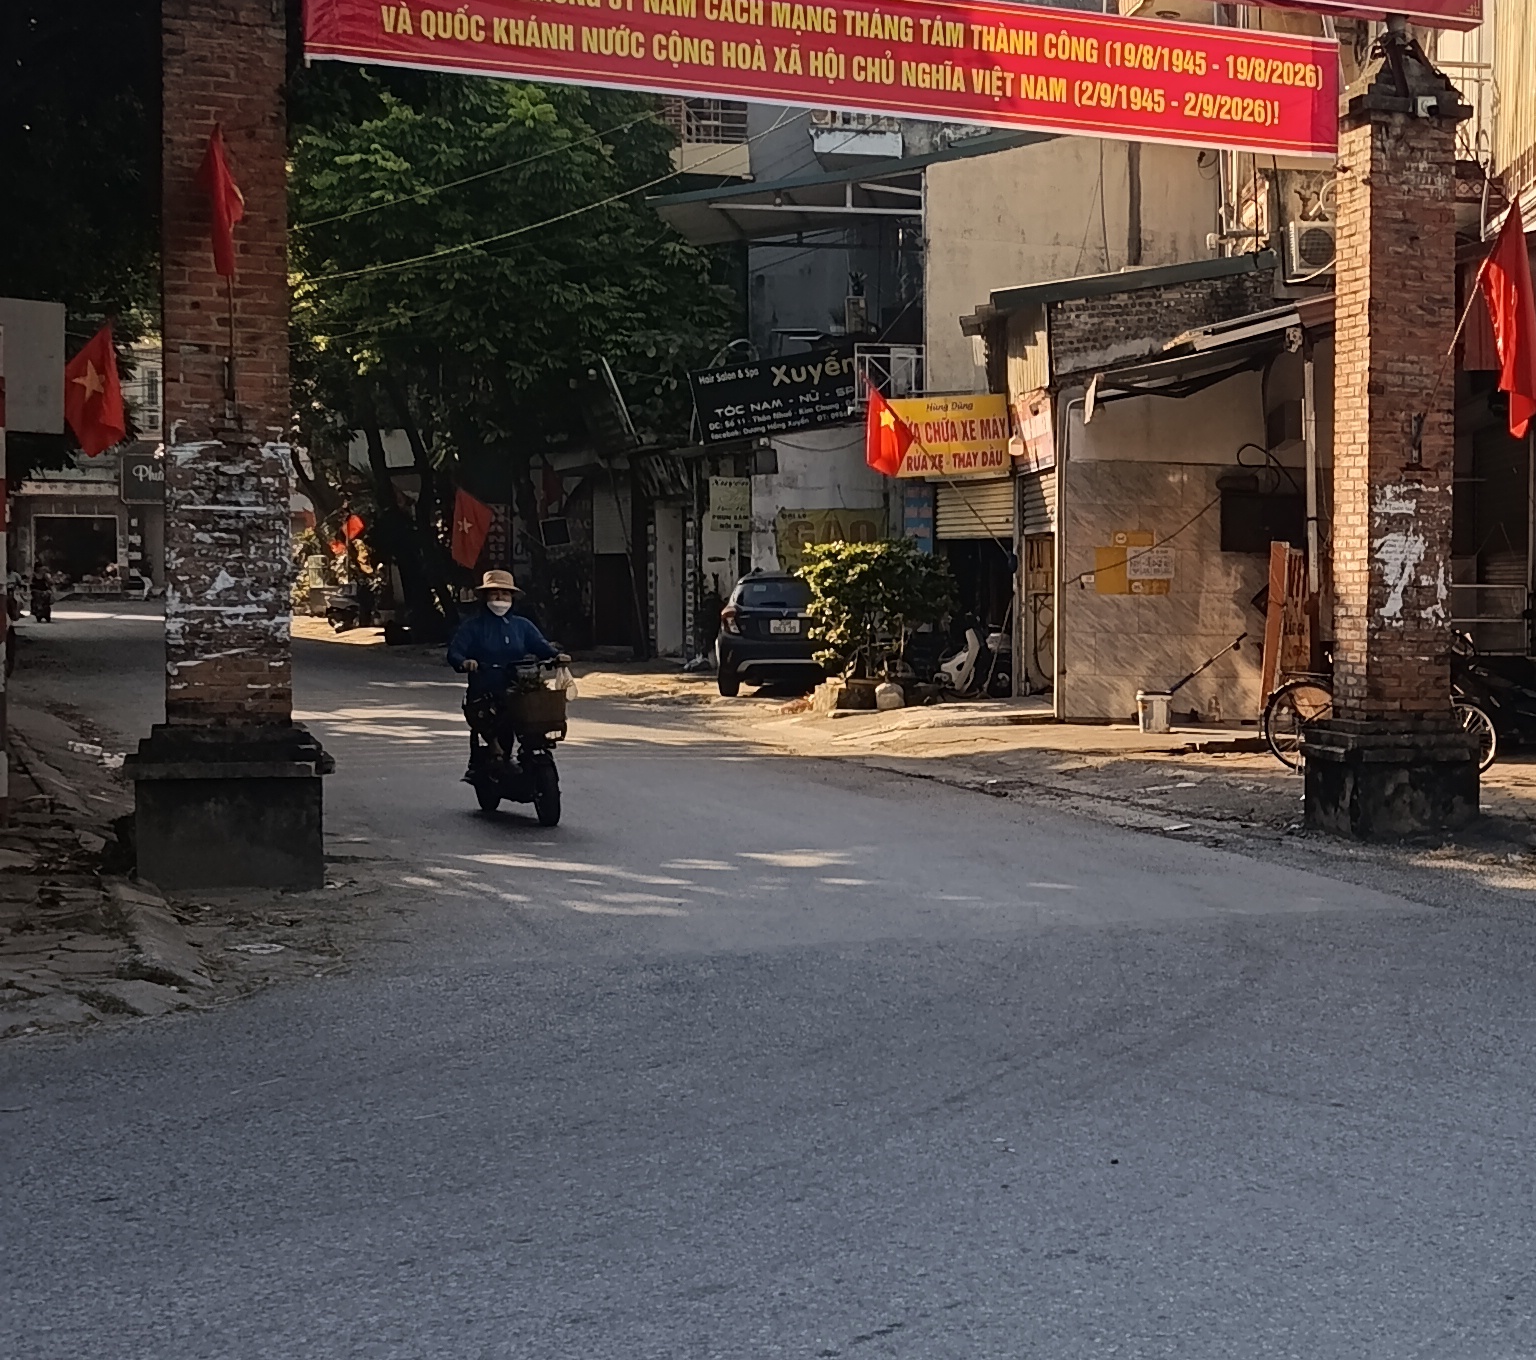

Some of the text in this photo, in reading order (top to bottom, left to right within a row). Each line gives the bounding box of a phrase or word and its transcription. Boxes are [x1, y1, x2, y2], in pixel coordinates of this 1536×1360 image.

[771, 1, 837, 36] MẠNG
[843, 8, 914, 42] THÁNG
[920, 14, 965, 48] TÁM
[971, 21, 1038, 58] THÀNH
[1044, 29, 1098, 64] CÔNG
[1105, 41, 1207, 76] (19/8/1945
[1225, 54, 1323, 90] 19/8/2026)
[381, 3, 413, 35] VÀ
[421, 4, 485, 42] QUỐC
[493, 13, 574, 52] KHÁNH
[581, 21, 645, 58] NƯỚC
[652, 31, 715, 71] CỘNG
[722, 39, 767, 71] HOÀ
[773, 42, 803, 76] XÃ
[809, 48, 846, 83] HỘI
[852, 51, 895, 85] CHỦ
[901, 57, 966, 93] NGHĨA
[972, 65, 1015, 101] VIỆT
[1021, 75, 1067, 104] NAM
[1073, 79, 1166, 114] (2/9/1945
[1184, 91, 1279, 125] 2/9/2026)!
[699, 349, 855, 387] Hair Salon & Spa Xuyến
[714, 404, 745, 418] TÓC
[750, 398, 783, 412] NAM
[835, 386, 855, 397] SP
[924, 416, 958, 443] CHỮA
[961, 419, 977, 441] XE
[980, 413, 1006, 440] MÁY
[930, 453, 943, 470] XE
[952, 451, 978, 469] THAY
[981, 444, 1003, 467] DẦU
